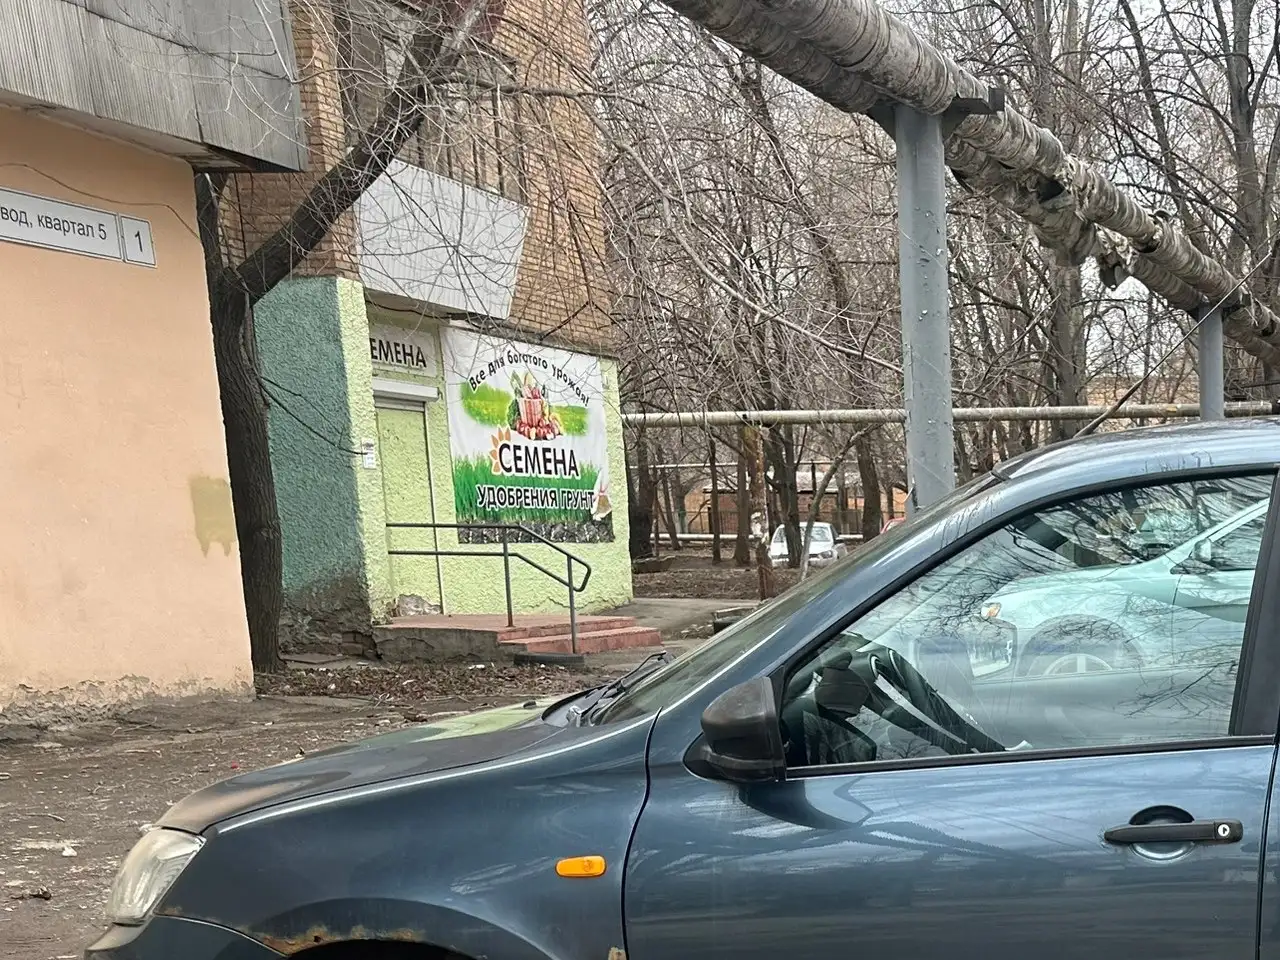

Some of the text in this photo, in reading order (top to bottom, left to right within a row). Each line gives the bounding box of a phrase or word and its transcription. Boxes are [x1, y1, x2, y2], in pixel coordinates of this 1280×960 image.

[37, 213, 95, 239] квартал
[98, 223, 107, 241] 5
[134, 230, 144, 253] 1
[469, 350, 590, 408] Все для богатого урожая!
[498, 442, 580, 477] СЕМЕНА
[476, 485, 594, 509] УДОБРЕНИЯ ГРУНТ
